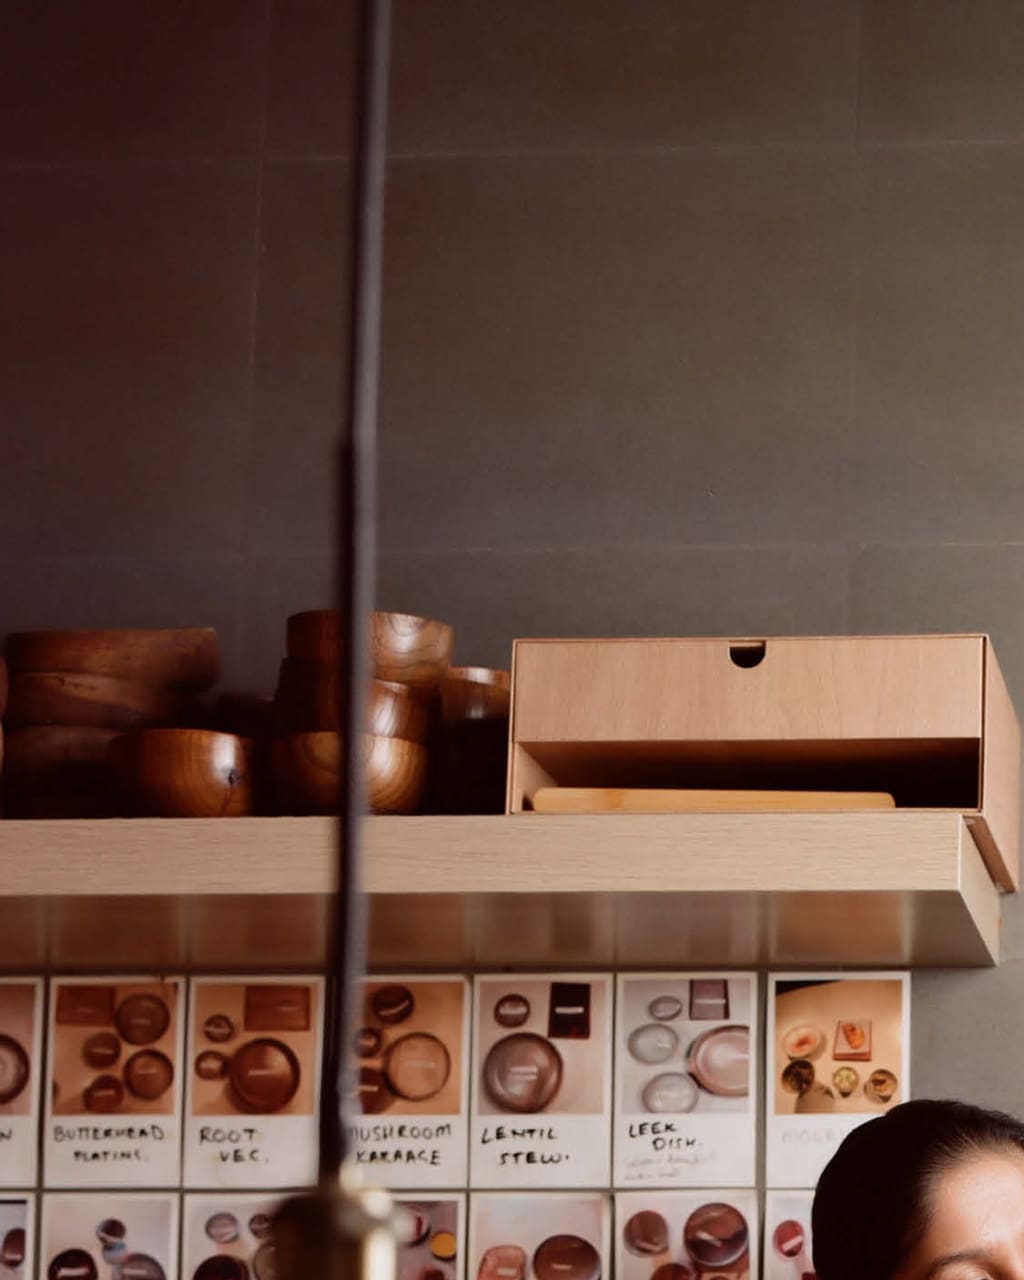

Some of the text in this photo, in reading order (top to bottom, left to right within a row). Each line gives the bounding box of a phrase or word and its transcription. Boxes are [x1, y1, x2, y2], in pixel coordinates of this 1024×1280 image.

[199, 1126, 258, 1144] ROOT
[481, 1126, 557, 1144] LENTIL
[628, 1122, 678, 1138] LEEK
